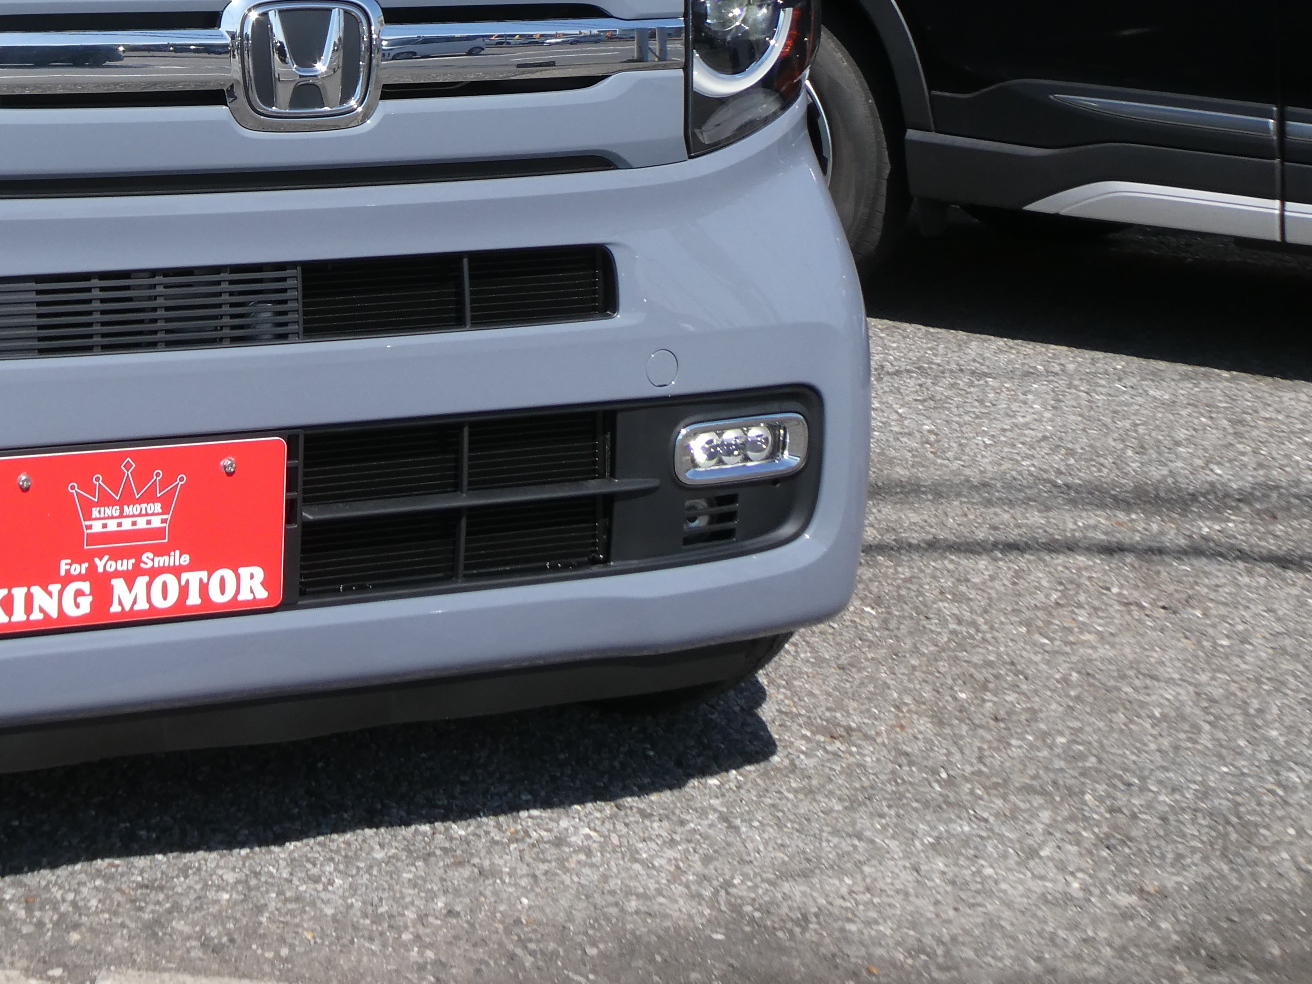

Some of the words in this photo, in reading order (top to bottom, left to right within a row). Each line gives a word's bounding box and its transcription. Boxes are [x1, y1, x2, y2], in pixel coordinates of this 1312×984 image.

[91, 505, 120, 518] KING
[123, 502, 162, 516] MOTOR
[59, 559, 88, 576] For
[93, 555, 136, 573] Your
[140, 550, 190, 569] Smile
[109, 565, 269, 613] MOTOR
